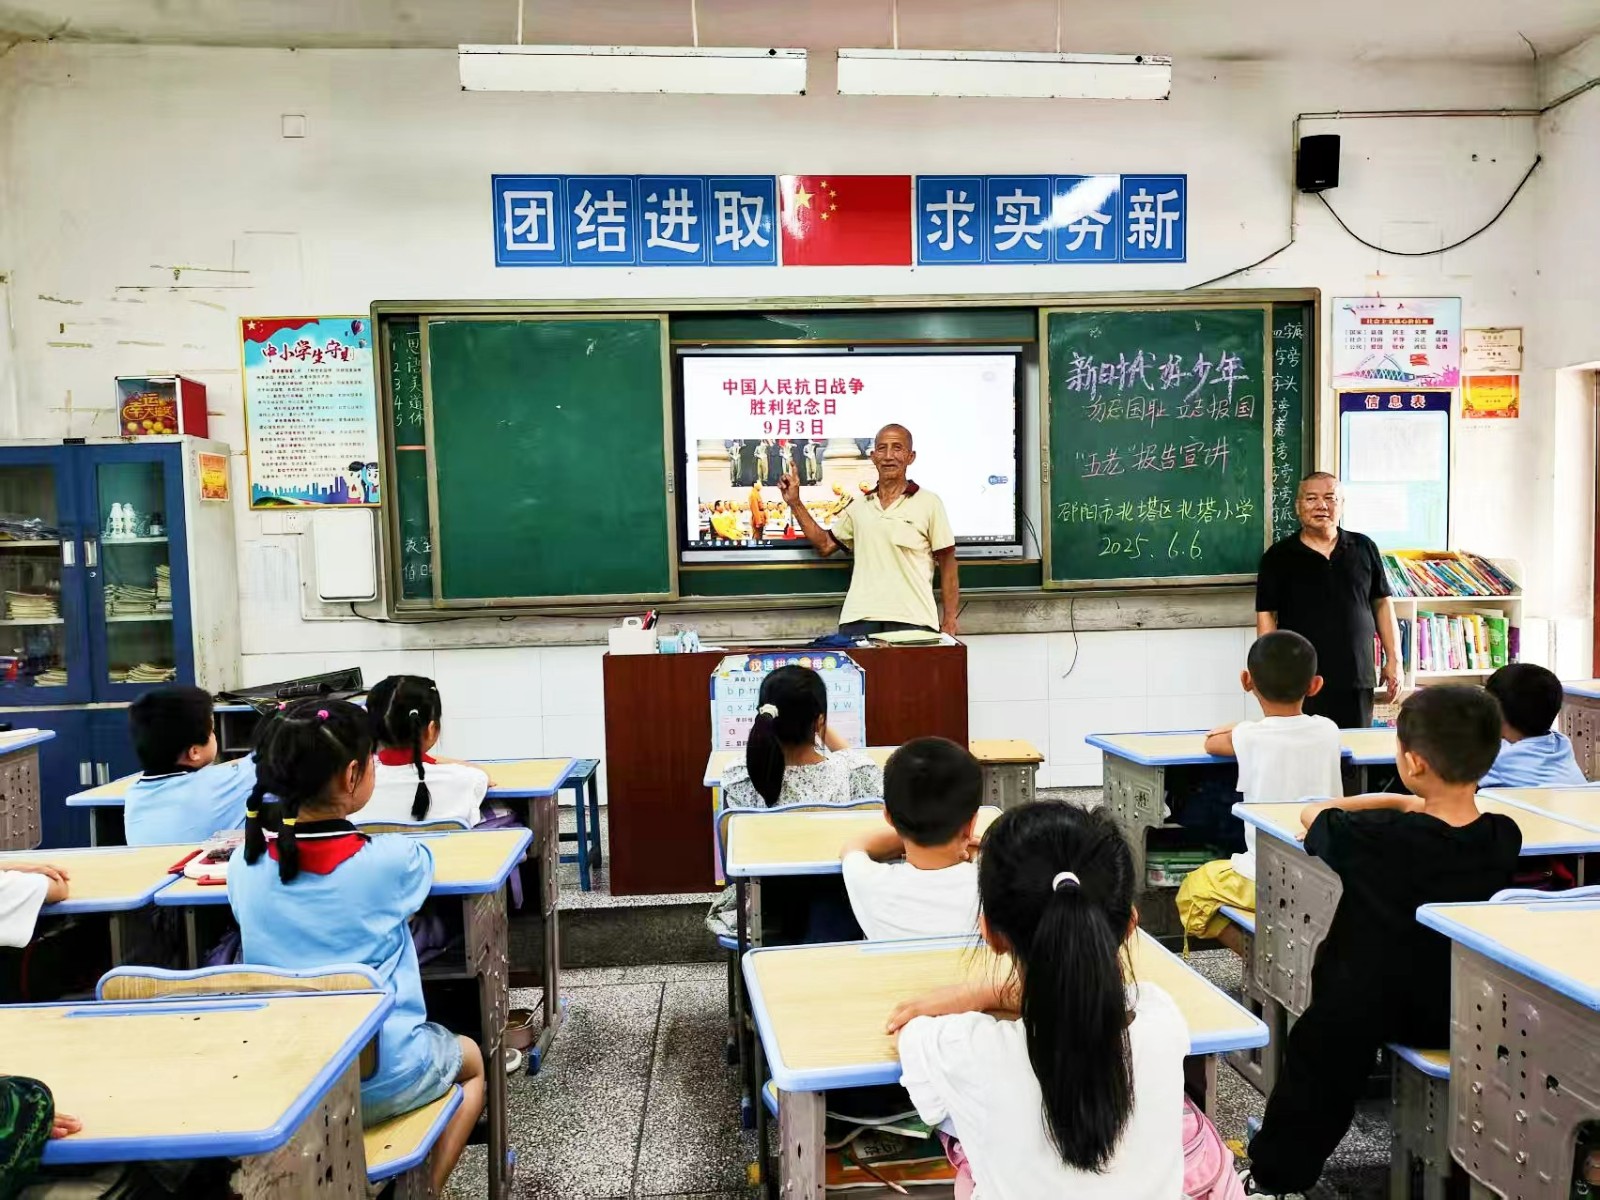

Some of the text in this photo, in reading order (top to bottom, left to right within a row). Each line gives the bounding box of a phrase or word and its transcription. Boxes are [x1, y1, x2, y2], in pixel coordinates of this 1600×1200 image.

[502, 187, 770, 254] 团结进取
[1065, 350, 1250, 404] 新时代好少年
[723, 378, 864, 396] 中国人民抗日战争
[750, 398, 837, 415] 胜利纪念日
[1365, 394, 1426, 409] 信息表
[1087, 395, 1171, 429] 勿忘国耻
[763, 418, 824, 435] 9月3日
